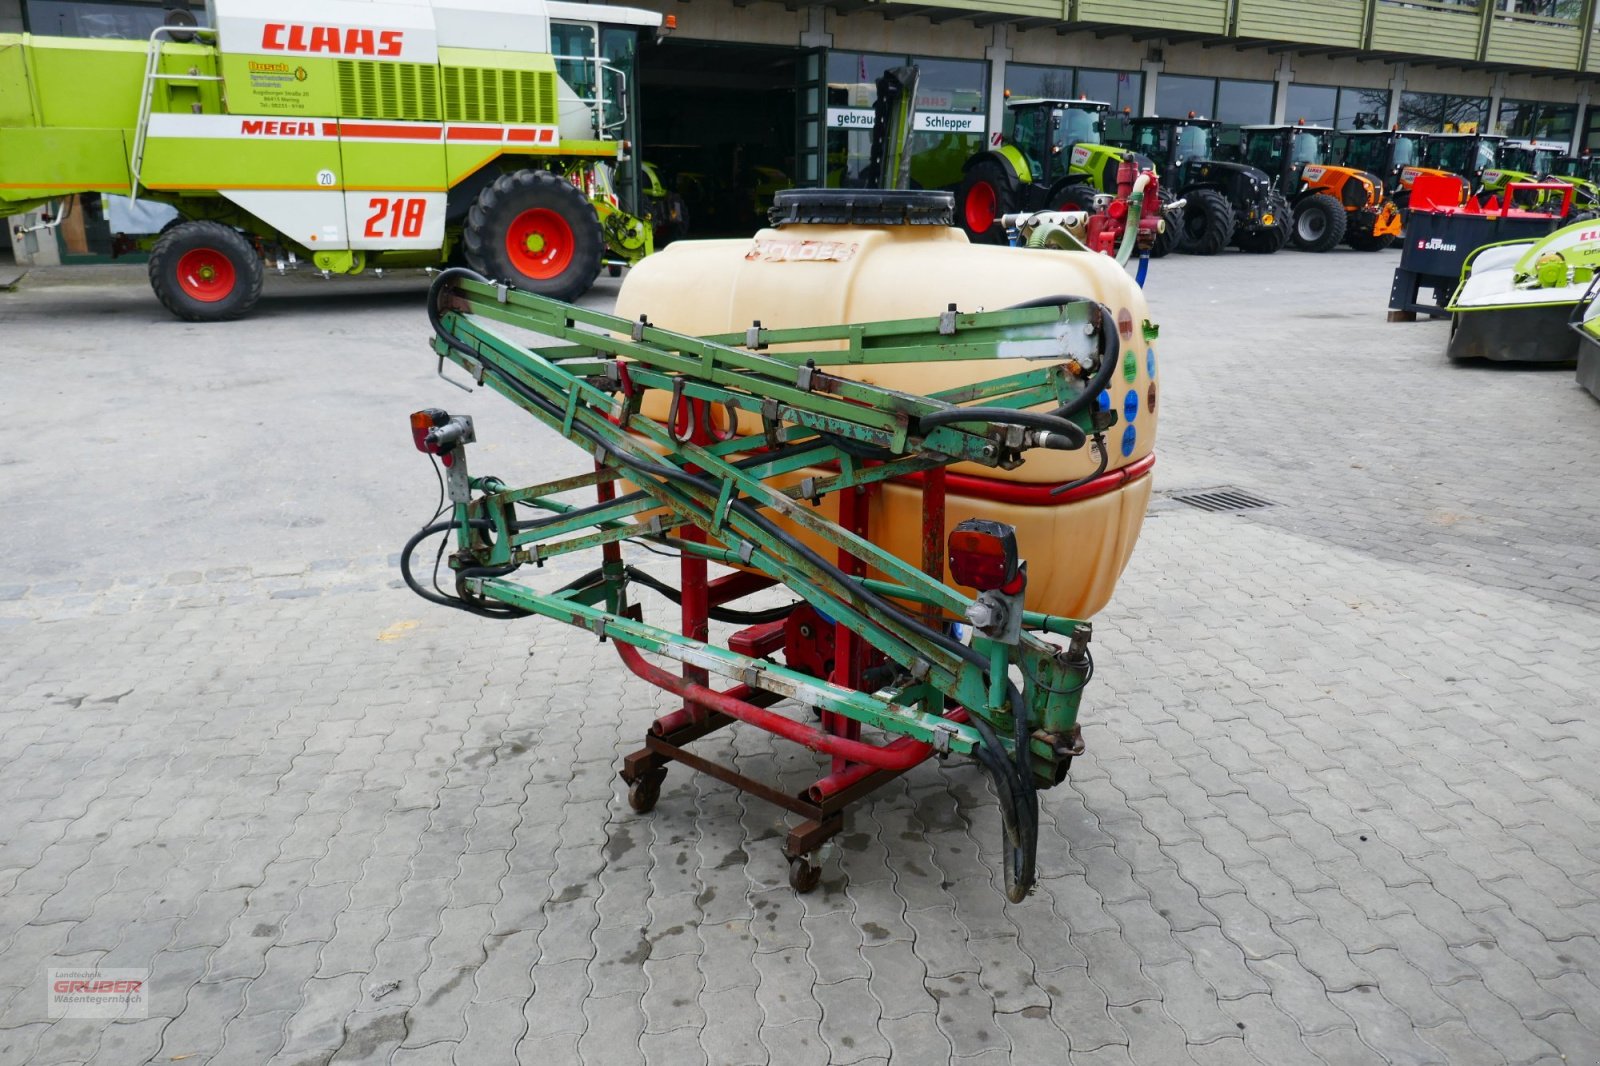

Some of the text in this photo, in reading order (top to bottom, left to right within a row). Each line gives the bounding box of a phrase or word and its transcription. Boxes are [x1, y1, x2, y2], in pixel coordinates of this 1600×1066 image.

[262, 24, 404, 56] CLAAS
[241, 120, 315, 136] MEGA
[837, 112, 972, 131] gebrau Schlepper
[320, 172, 332, 185] 20
[363, 198, 427, 238] 218
[1425, 242, 1457, 252] SAPHIR
